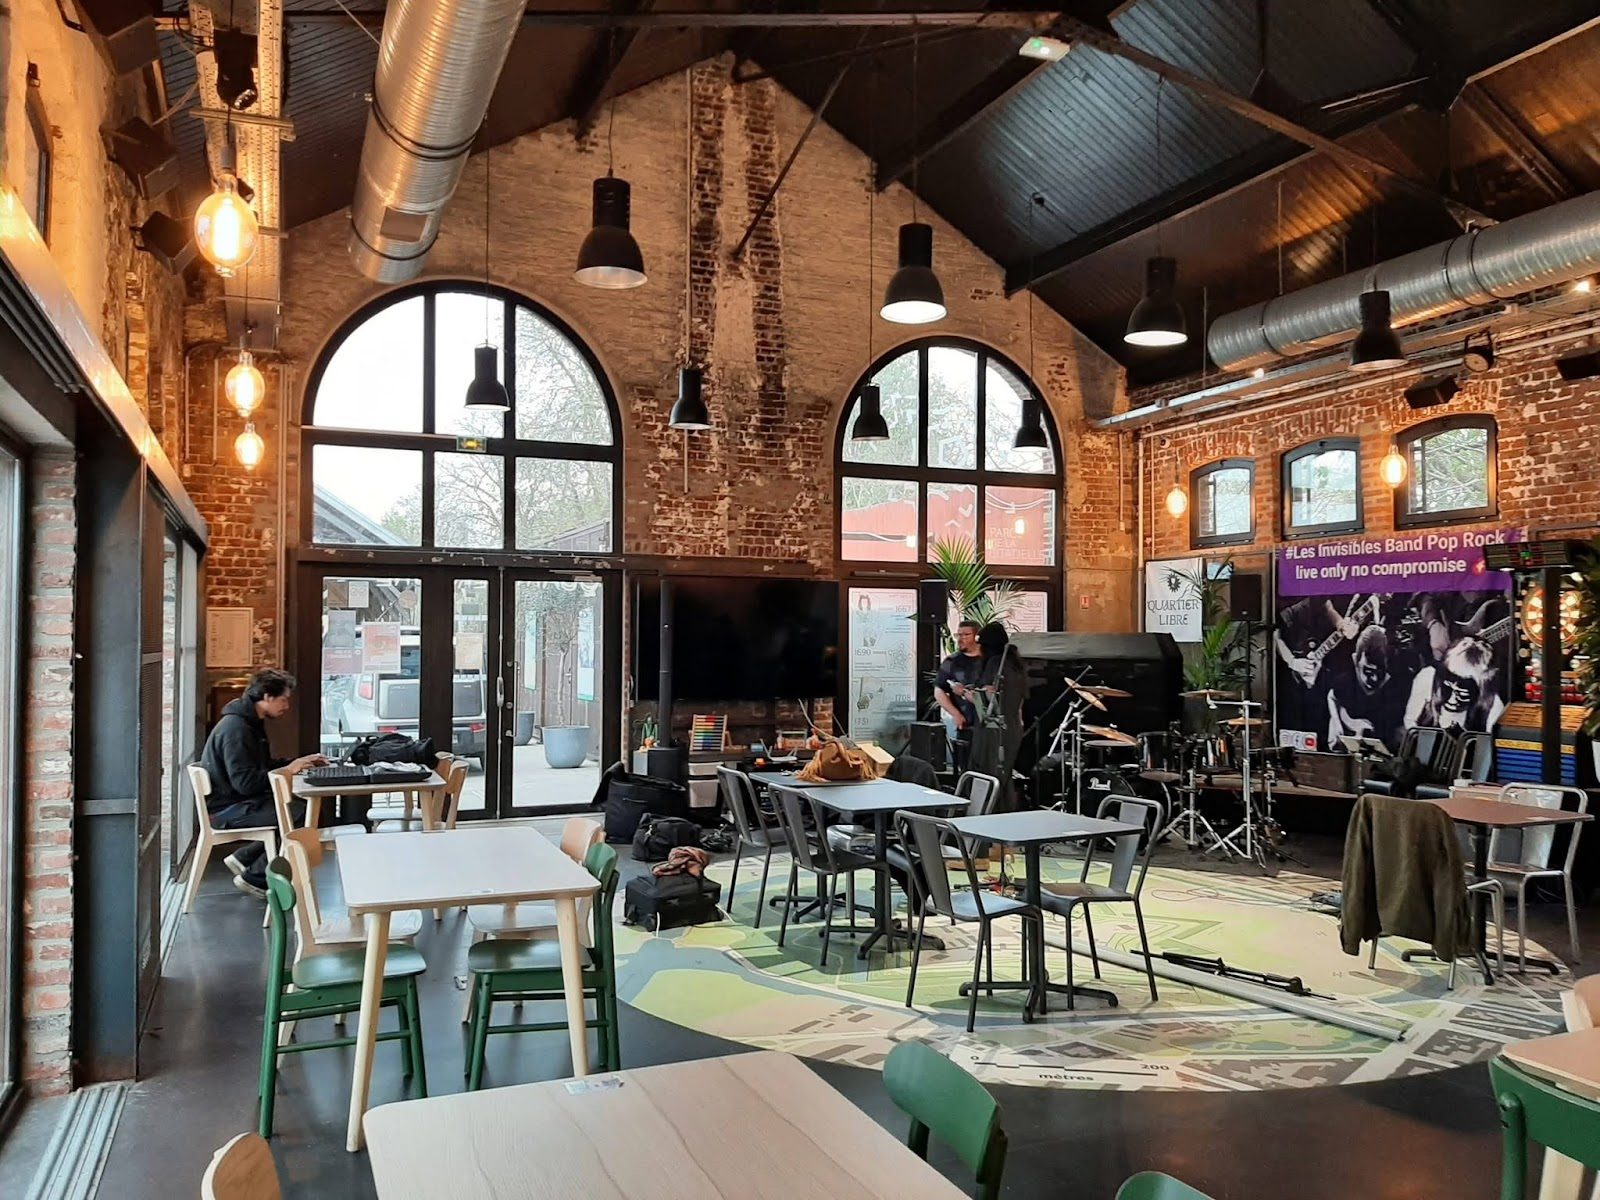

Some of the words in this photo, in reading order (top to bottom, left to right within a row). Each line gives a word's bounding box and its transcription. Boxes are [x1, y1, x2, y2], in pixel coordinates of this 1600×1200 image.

[1285, 545, 1316, 560] #Les
[1318, 539, 1382, 558] Invisibles
[1384, 535, 1423, 553] Band
[1427, 534, 1458, 552] Pop
[1463, 529, 1505, 548] Rock
[1295, 564, 1318, 579] live
[1320, 562, 1349, 581] only
[1351, 564, 1369, 577] no
[1371, 557, 1467, 578] compromise
[1147, 599, 1199, 613] QUARTIER
[1159, 613, 1188, 626] LIBRE
[1139, 1063, 1170, 1071] 200
